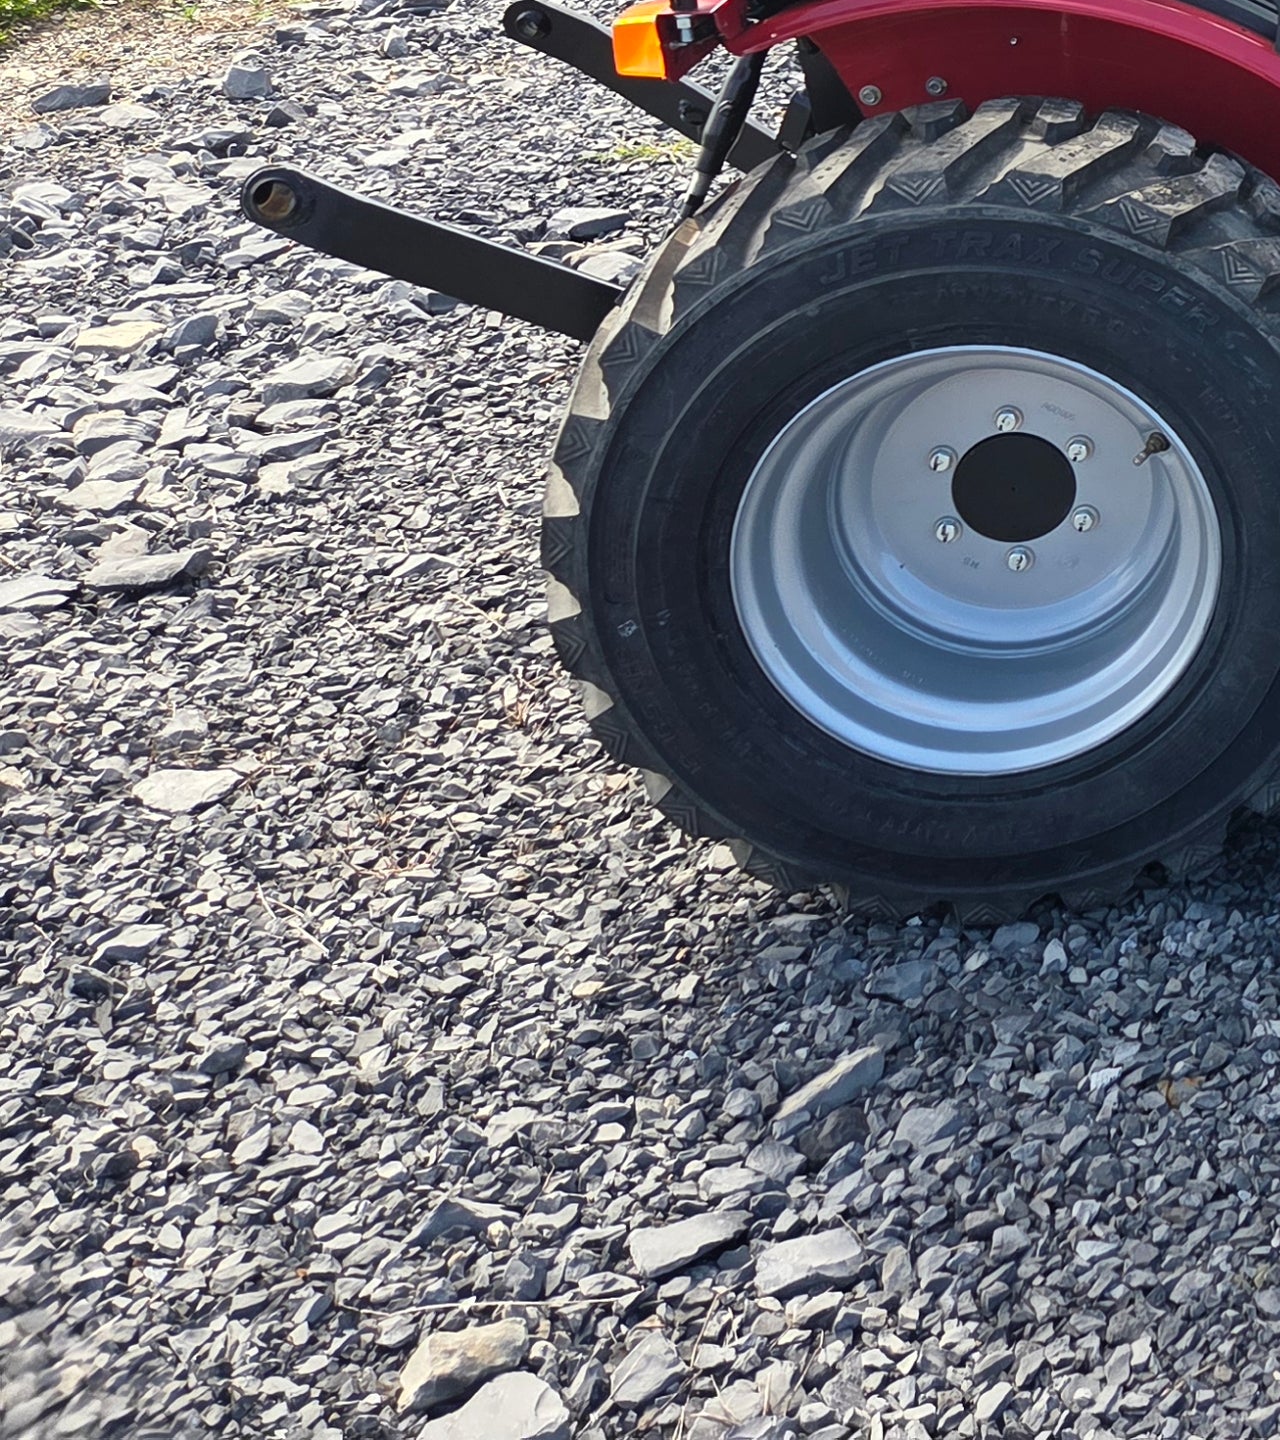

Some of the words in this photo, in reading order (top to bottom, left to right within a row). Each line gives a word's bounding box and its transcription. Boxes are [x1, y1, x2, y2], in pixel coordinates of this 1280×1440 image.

[819, 235, 910, 285] JET
[931, 230, 1064, 265] TRAX
[1072, 248, 1221, 332] SUPER
